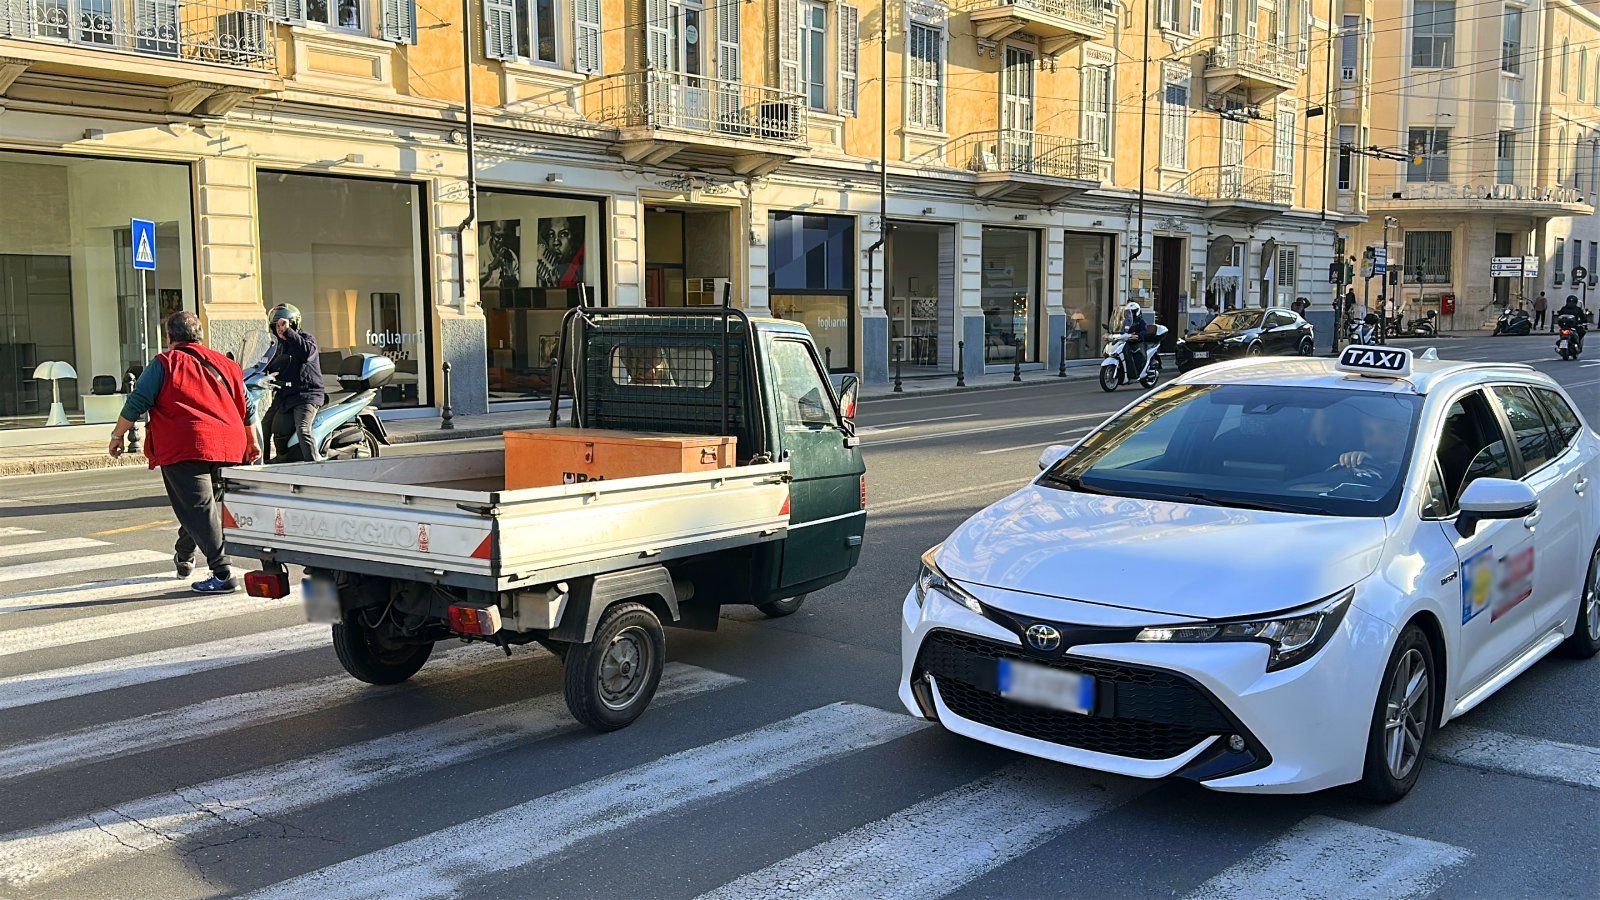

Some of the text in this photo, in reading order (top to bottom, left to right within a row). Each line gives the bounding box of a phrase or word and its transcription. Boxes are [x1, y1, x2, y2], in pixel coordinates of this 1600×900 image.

[366, 329, 424, 348] fogliarini
[1347, 350, 1402, 368] TAXI
[285, 509, 416, 548] PIAGGIO
